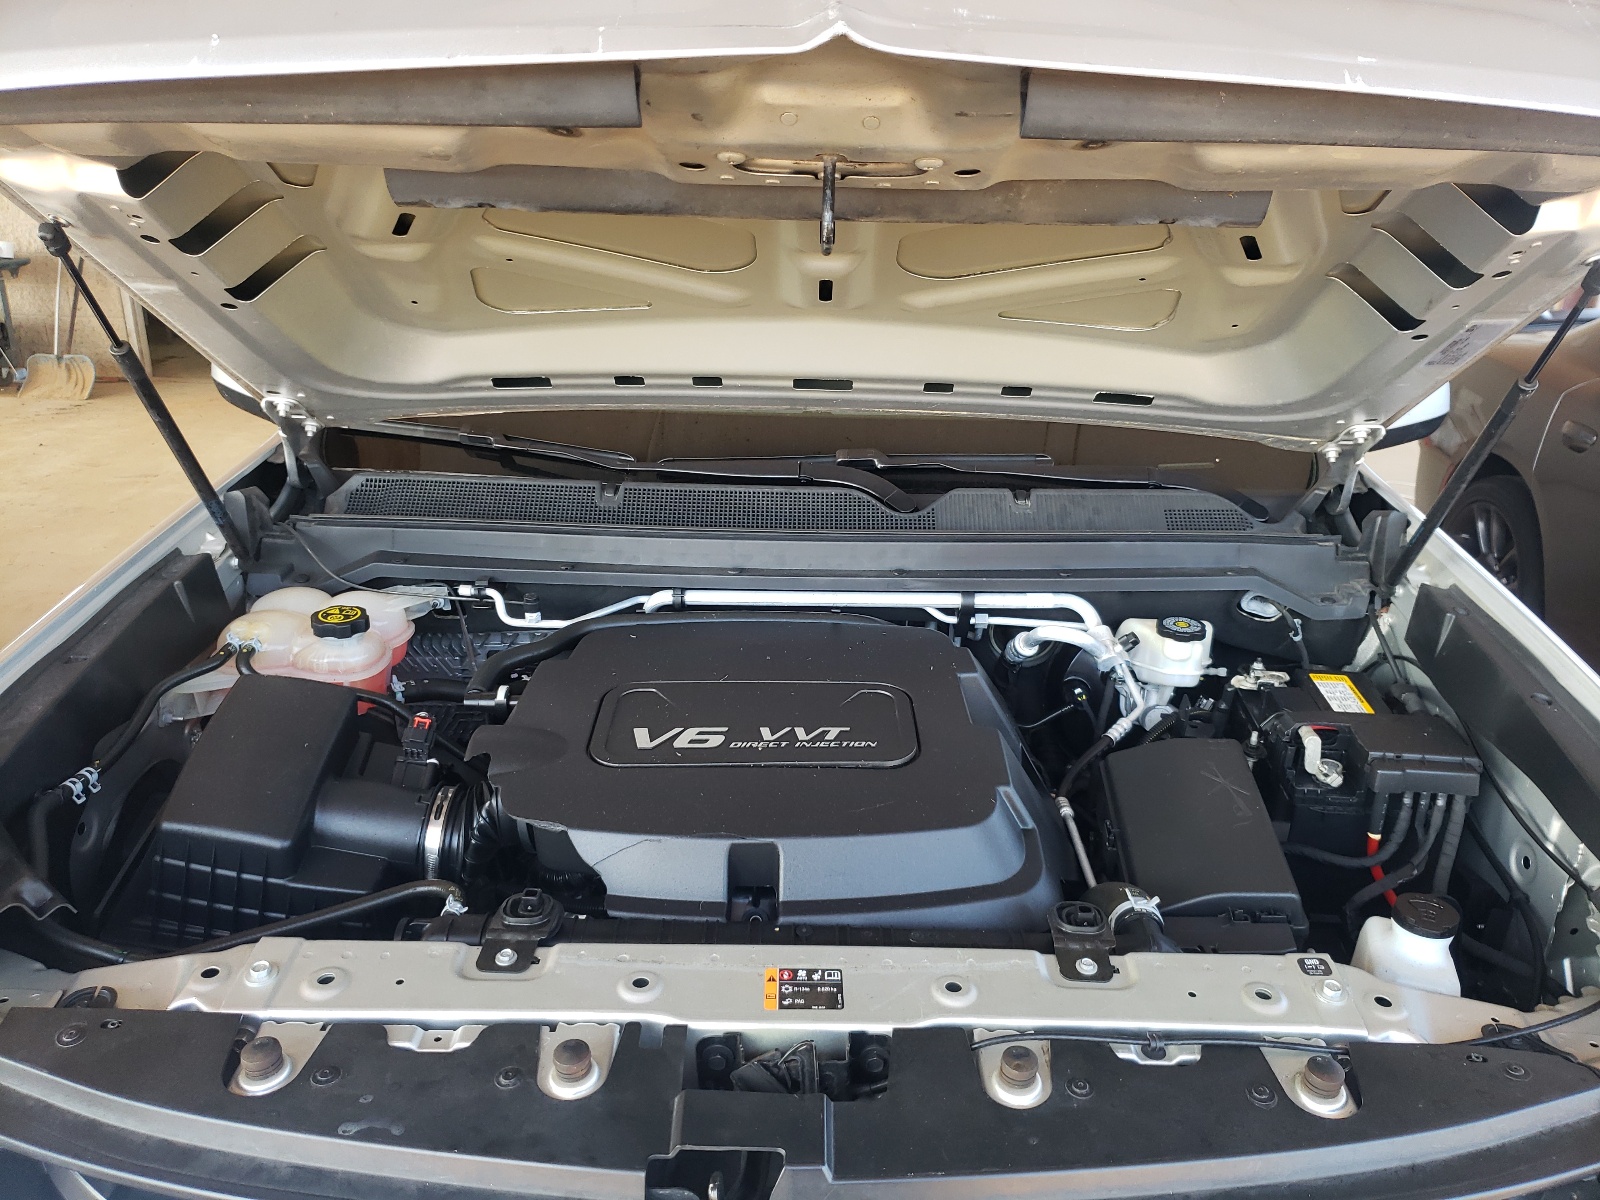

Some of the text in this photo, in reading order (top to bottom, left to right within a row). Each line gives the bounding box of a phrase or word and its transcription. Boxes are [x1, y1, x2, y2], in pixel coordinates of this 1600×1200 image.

[633, 727, 850, 750] V6 VVT
[729, 741, 878, 749] DIRECT INJECTION
